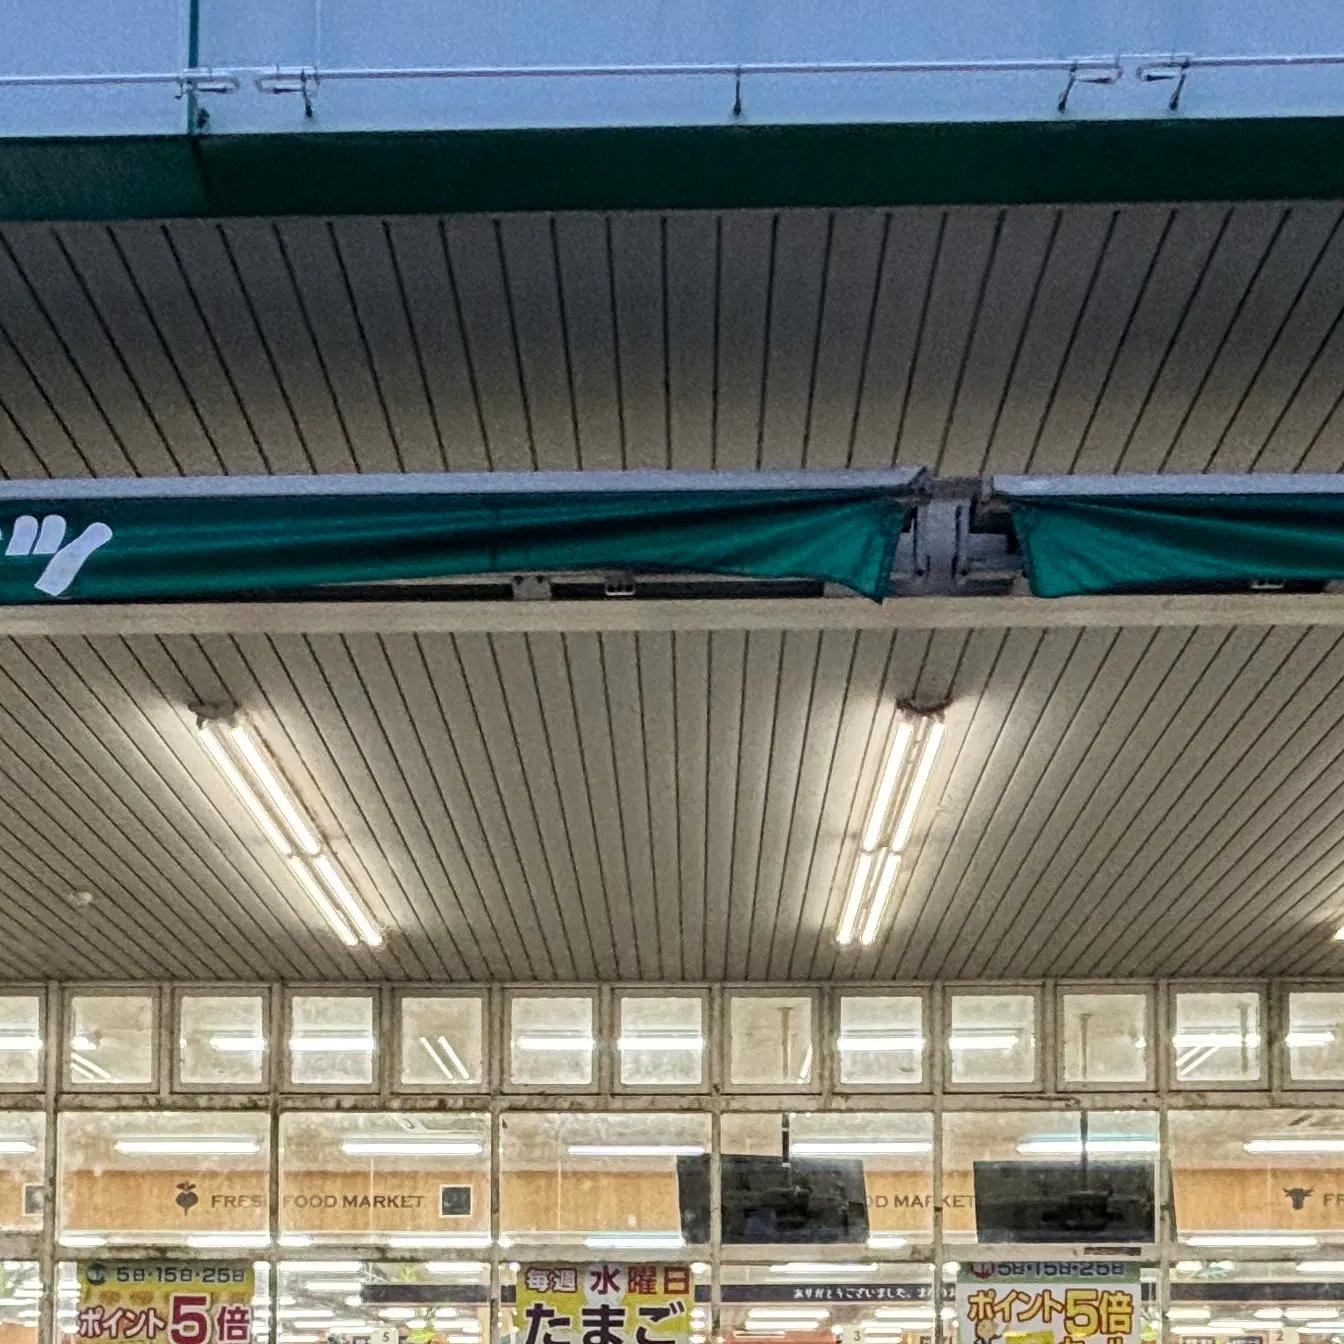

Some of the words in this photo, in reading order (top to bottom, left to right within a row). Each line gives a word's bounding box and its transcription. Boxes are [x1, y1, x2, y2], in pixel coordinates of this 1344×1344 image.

[342, 1195, 424, 1208] MARKET
[967, 1288, 1134, 1337] ポイント5倍
[382, 1332, 390, 1342] 5
